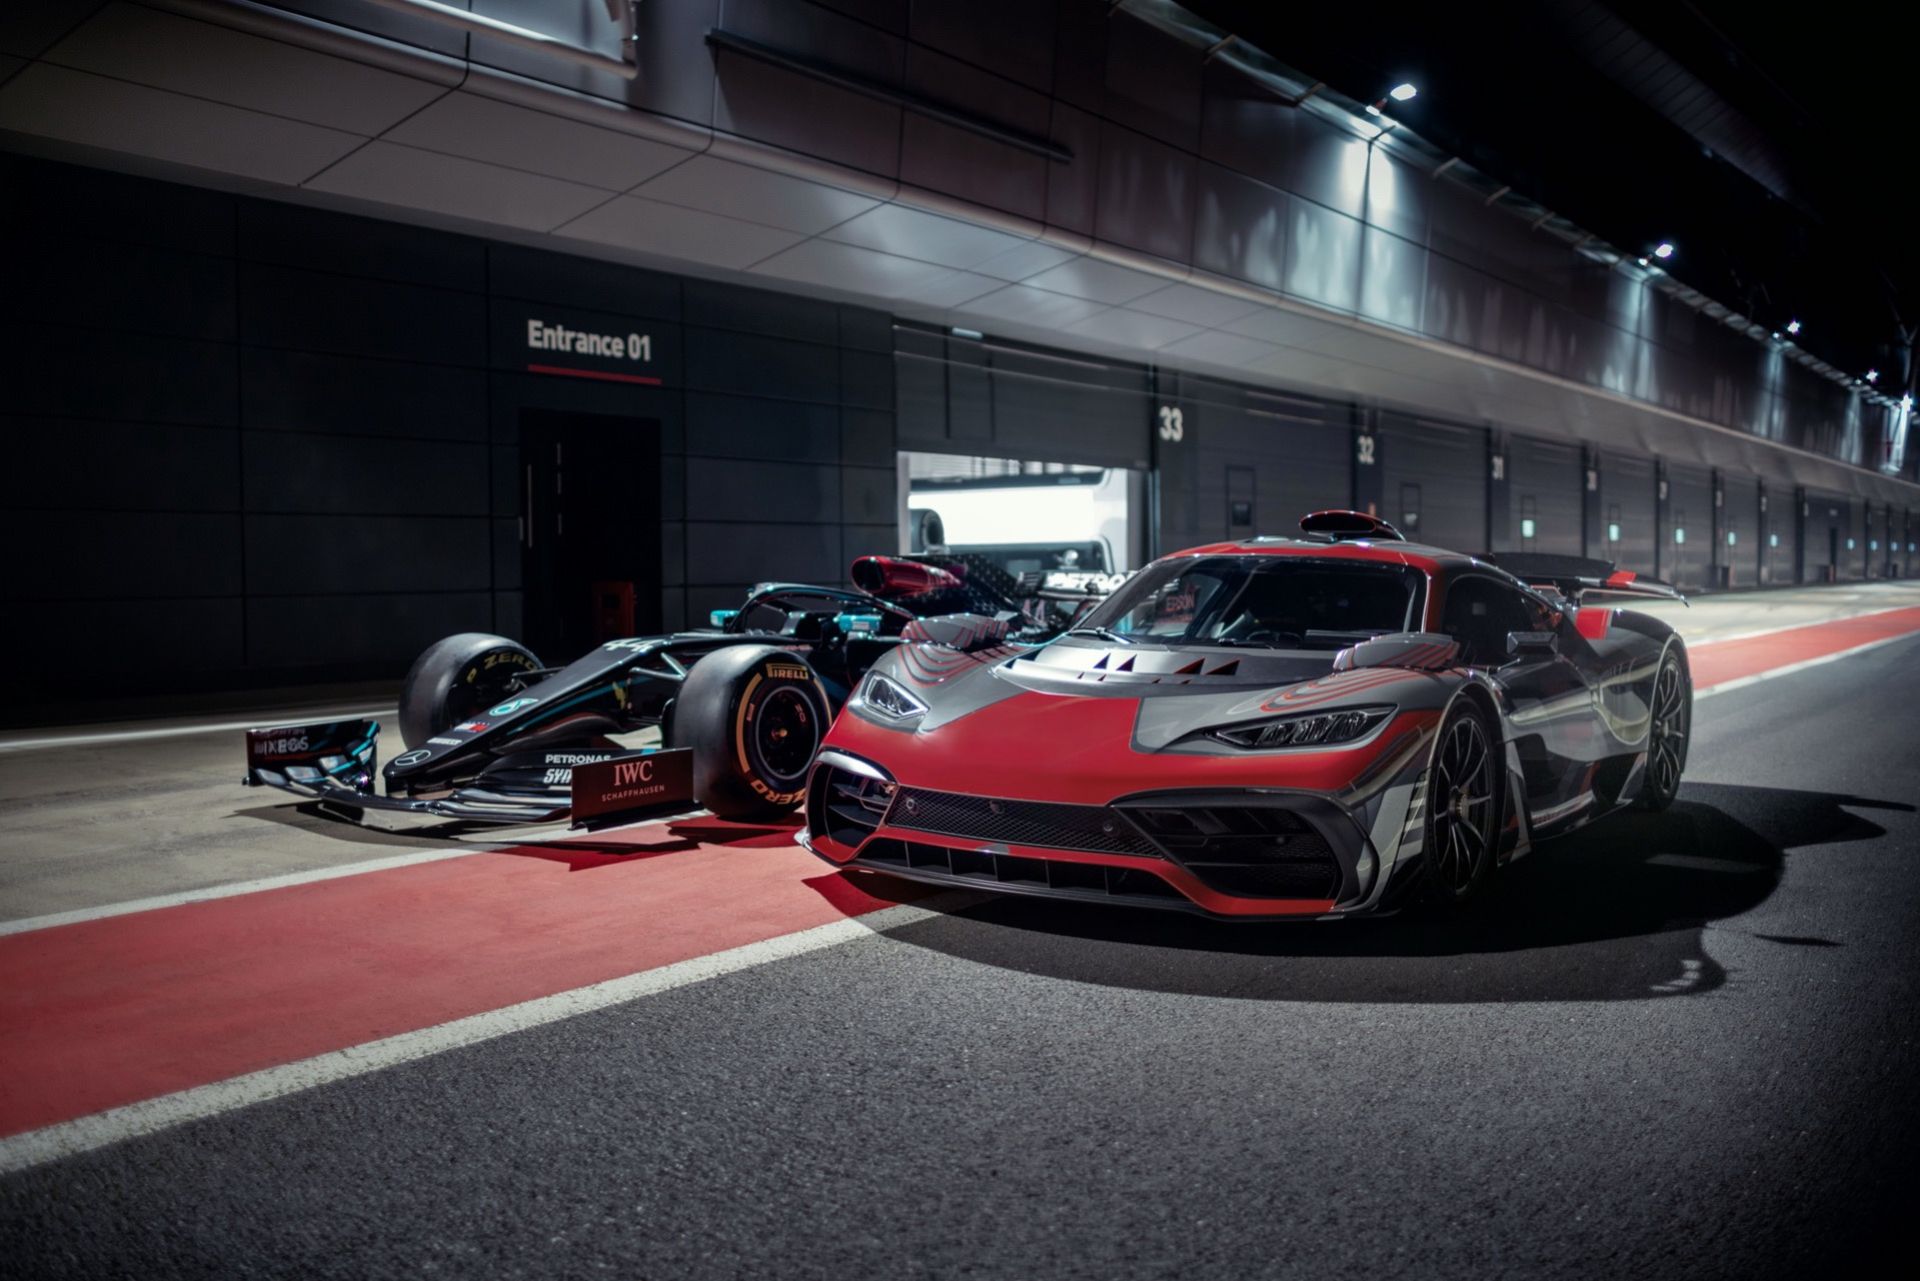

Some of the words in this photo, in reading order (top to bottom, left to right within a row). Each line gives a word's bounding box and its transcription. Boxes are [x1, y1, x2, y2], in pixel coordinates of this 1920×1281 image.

[528, 318, 625, 359] Entrance
[627, 333, 651, 362] 01
[1159, 405, 1184, 442] 33
[1357, 435, 1375, 465] 32
[484, 652, 539, 671] ZERO
[765, 662, 809, 680] PIRELLI
[545, 753, 612, 765] PETRONAS
[613, 760, 653, 787] IWC
[601, 784, 665, 802] SCHAFFHAUSEN
